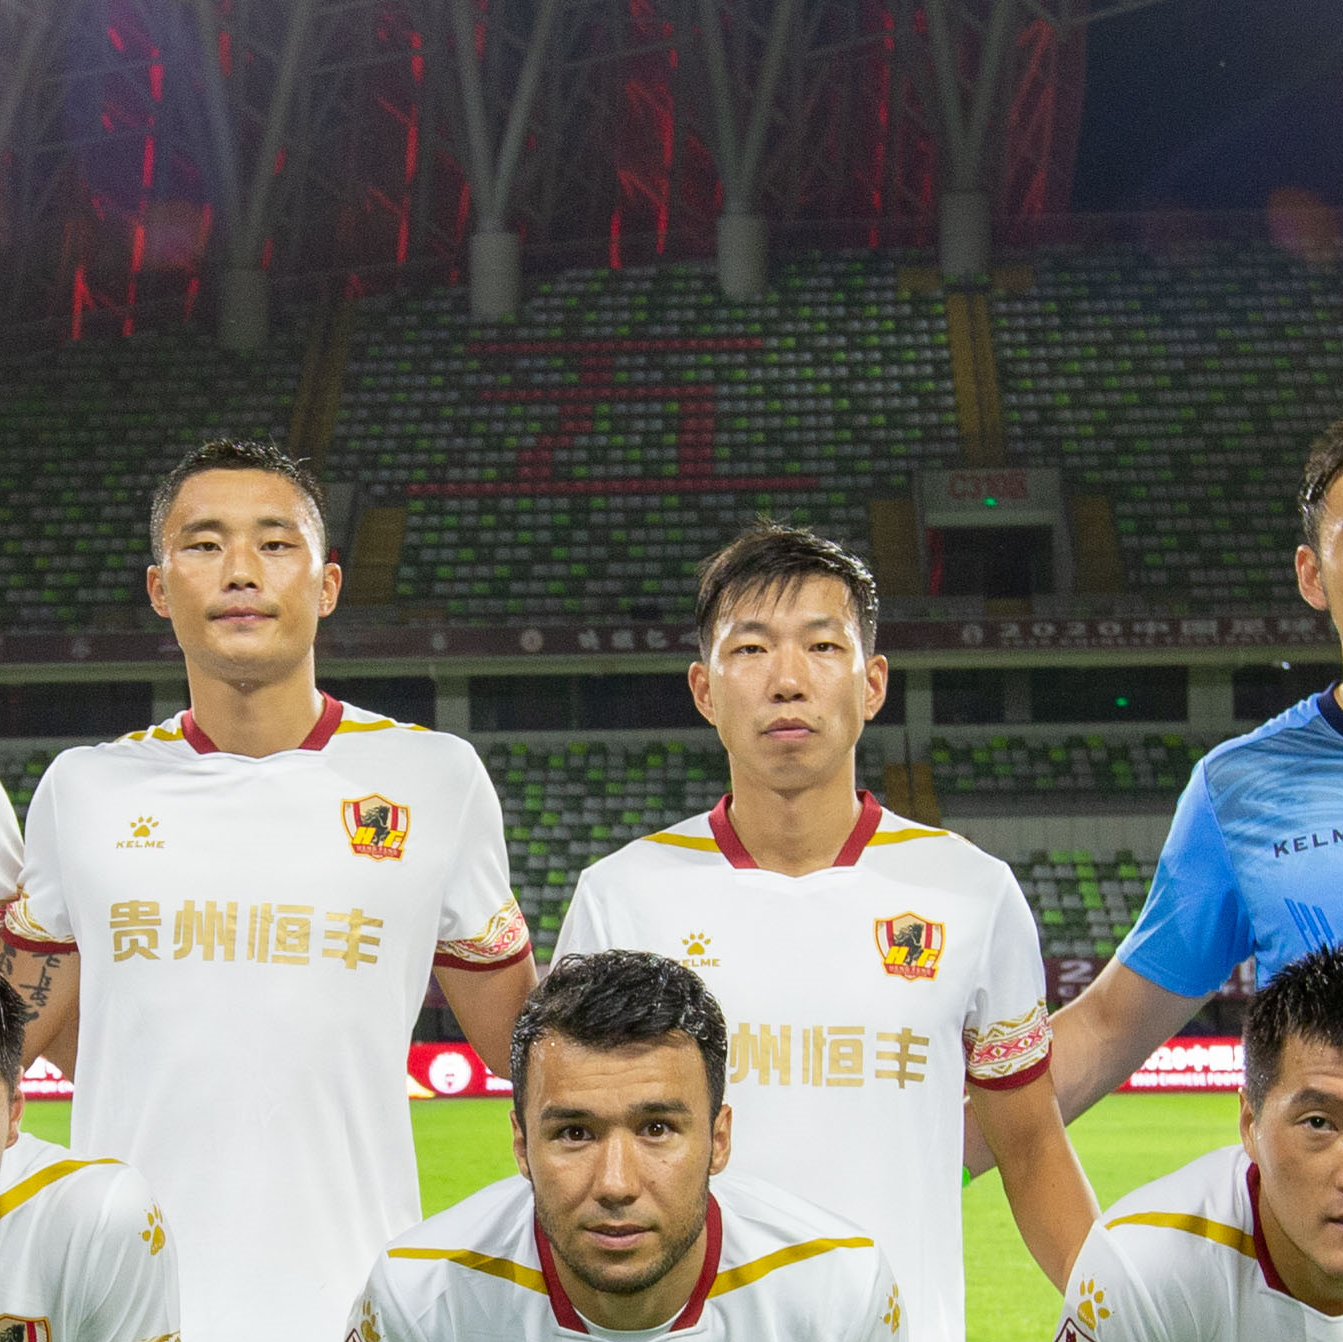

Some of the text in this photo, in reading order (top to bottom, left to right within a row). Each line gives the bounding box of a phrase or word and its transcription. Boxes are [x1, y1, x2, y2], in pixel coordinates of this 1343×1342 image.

[115, 840, 166, 849] KELME
[109, 899, 384, 970] 贵州恒丰
[730, 1022, 929, 1089] 州恒丰
